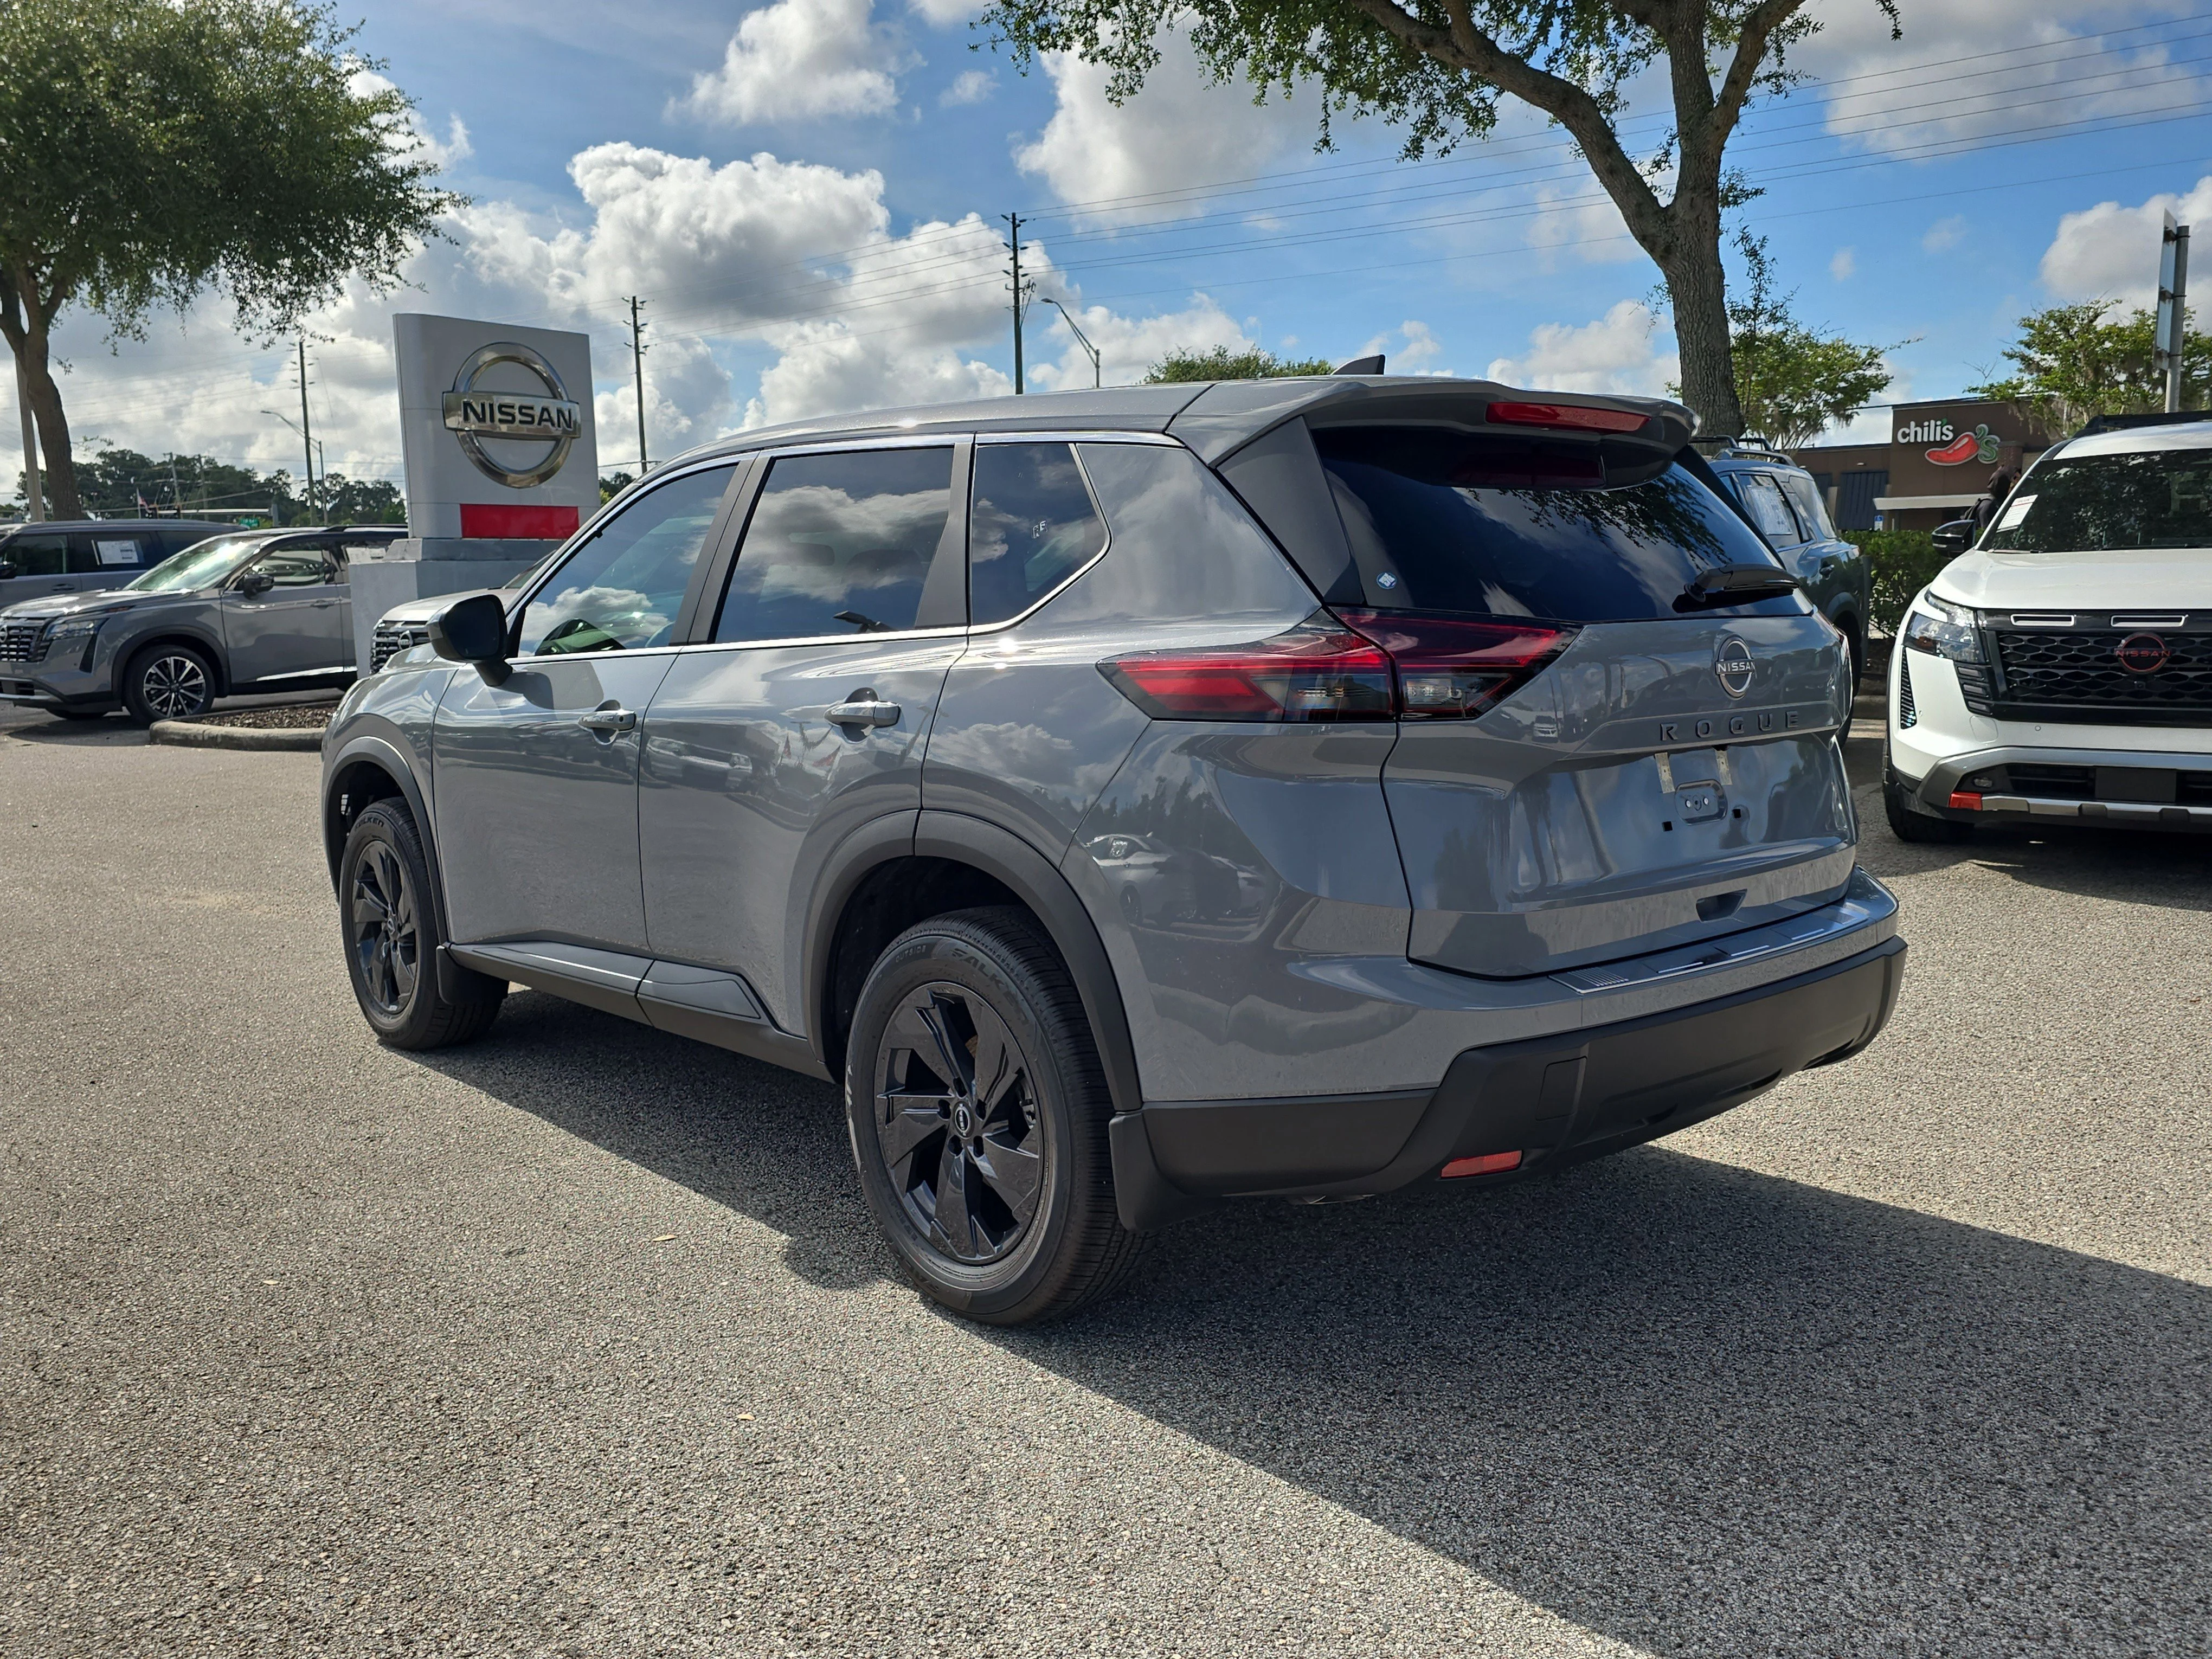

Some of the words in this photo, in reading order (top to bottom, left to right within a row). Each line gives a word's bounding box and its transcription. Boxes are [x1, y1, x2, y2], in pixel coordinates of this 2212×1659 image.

[462, 400, 572, 429] NISSAN
[1897, 418, 1954, 443] chili's
[1717, 660, 1757, 673] NISSAN
[1660, 711, 1799, 741] ROGUE
